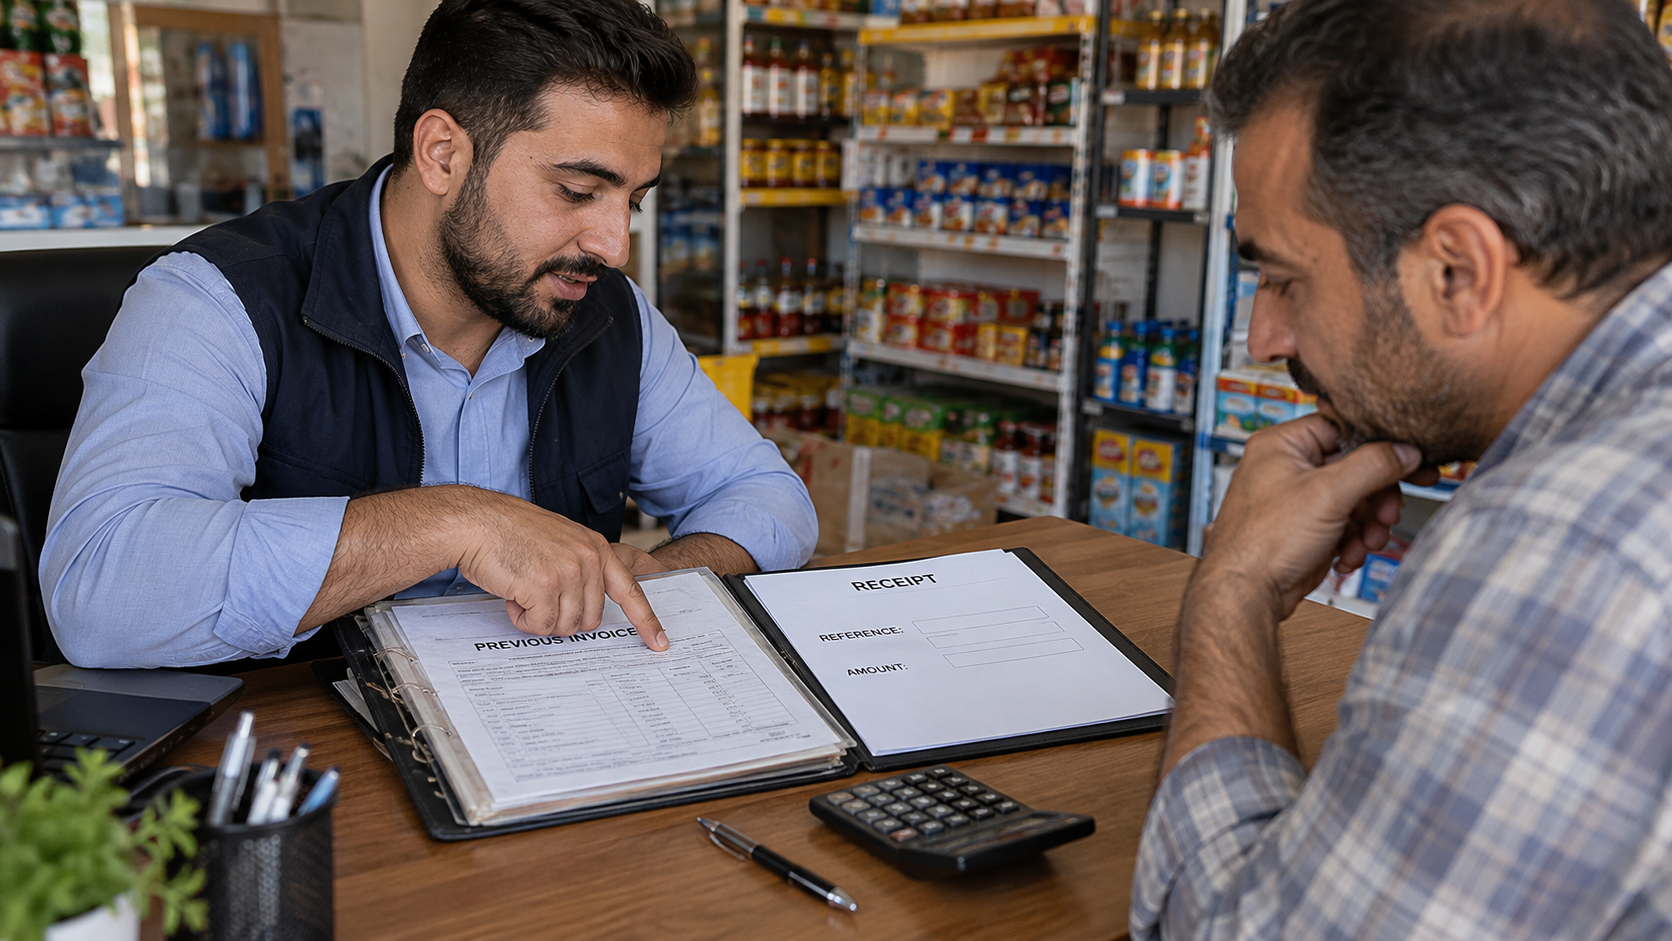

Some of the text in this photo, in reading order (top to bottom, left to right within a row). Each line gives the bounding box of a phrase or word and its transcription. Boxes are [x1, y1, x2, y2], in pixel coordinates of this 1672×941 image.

[851, 574, 938, 591] RECEIPT
[819, 626, 904, 642] REFERENCE:
[474, 636, 564, 651] PREVIOUS
[847, 663, 908, 676] AMOUNT:
